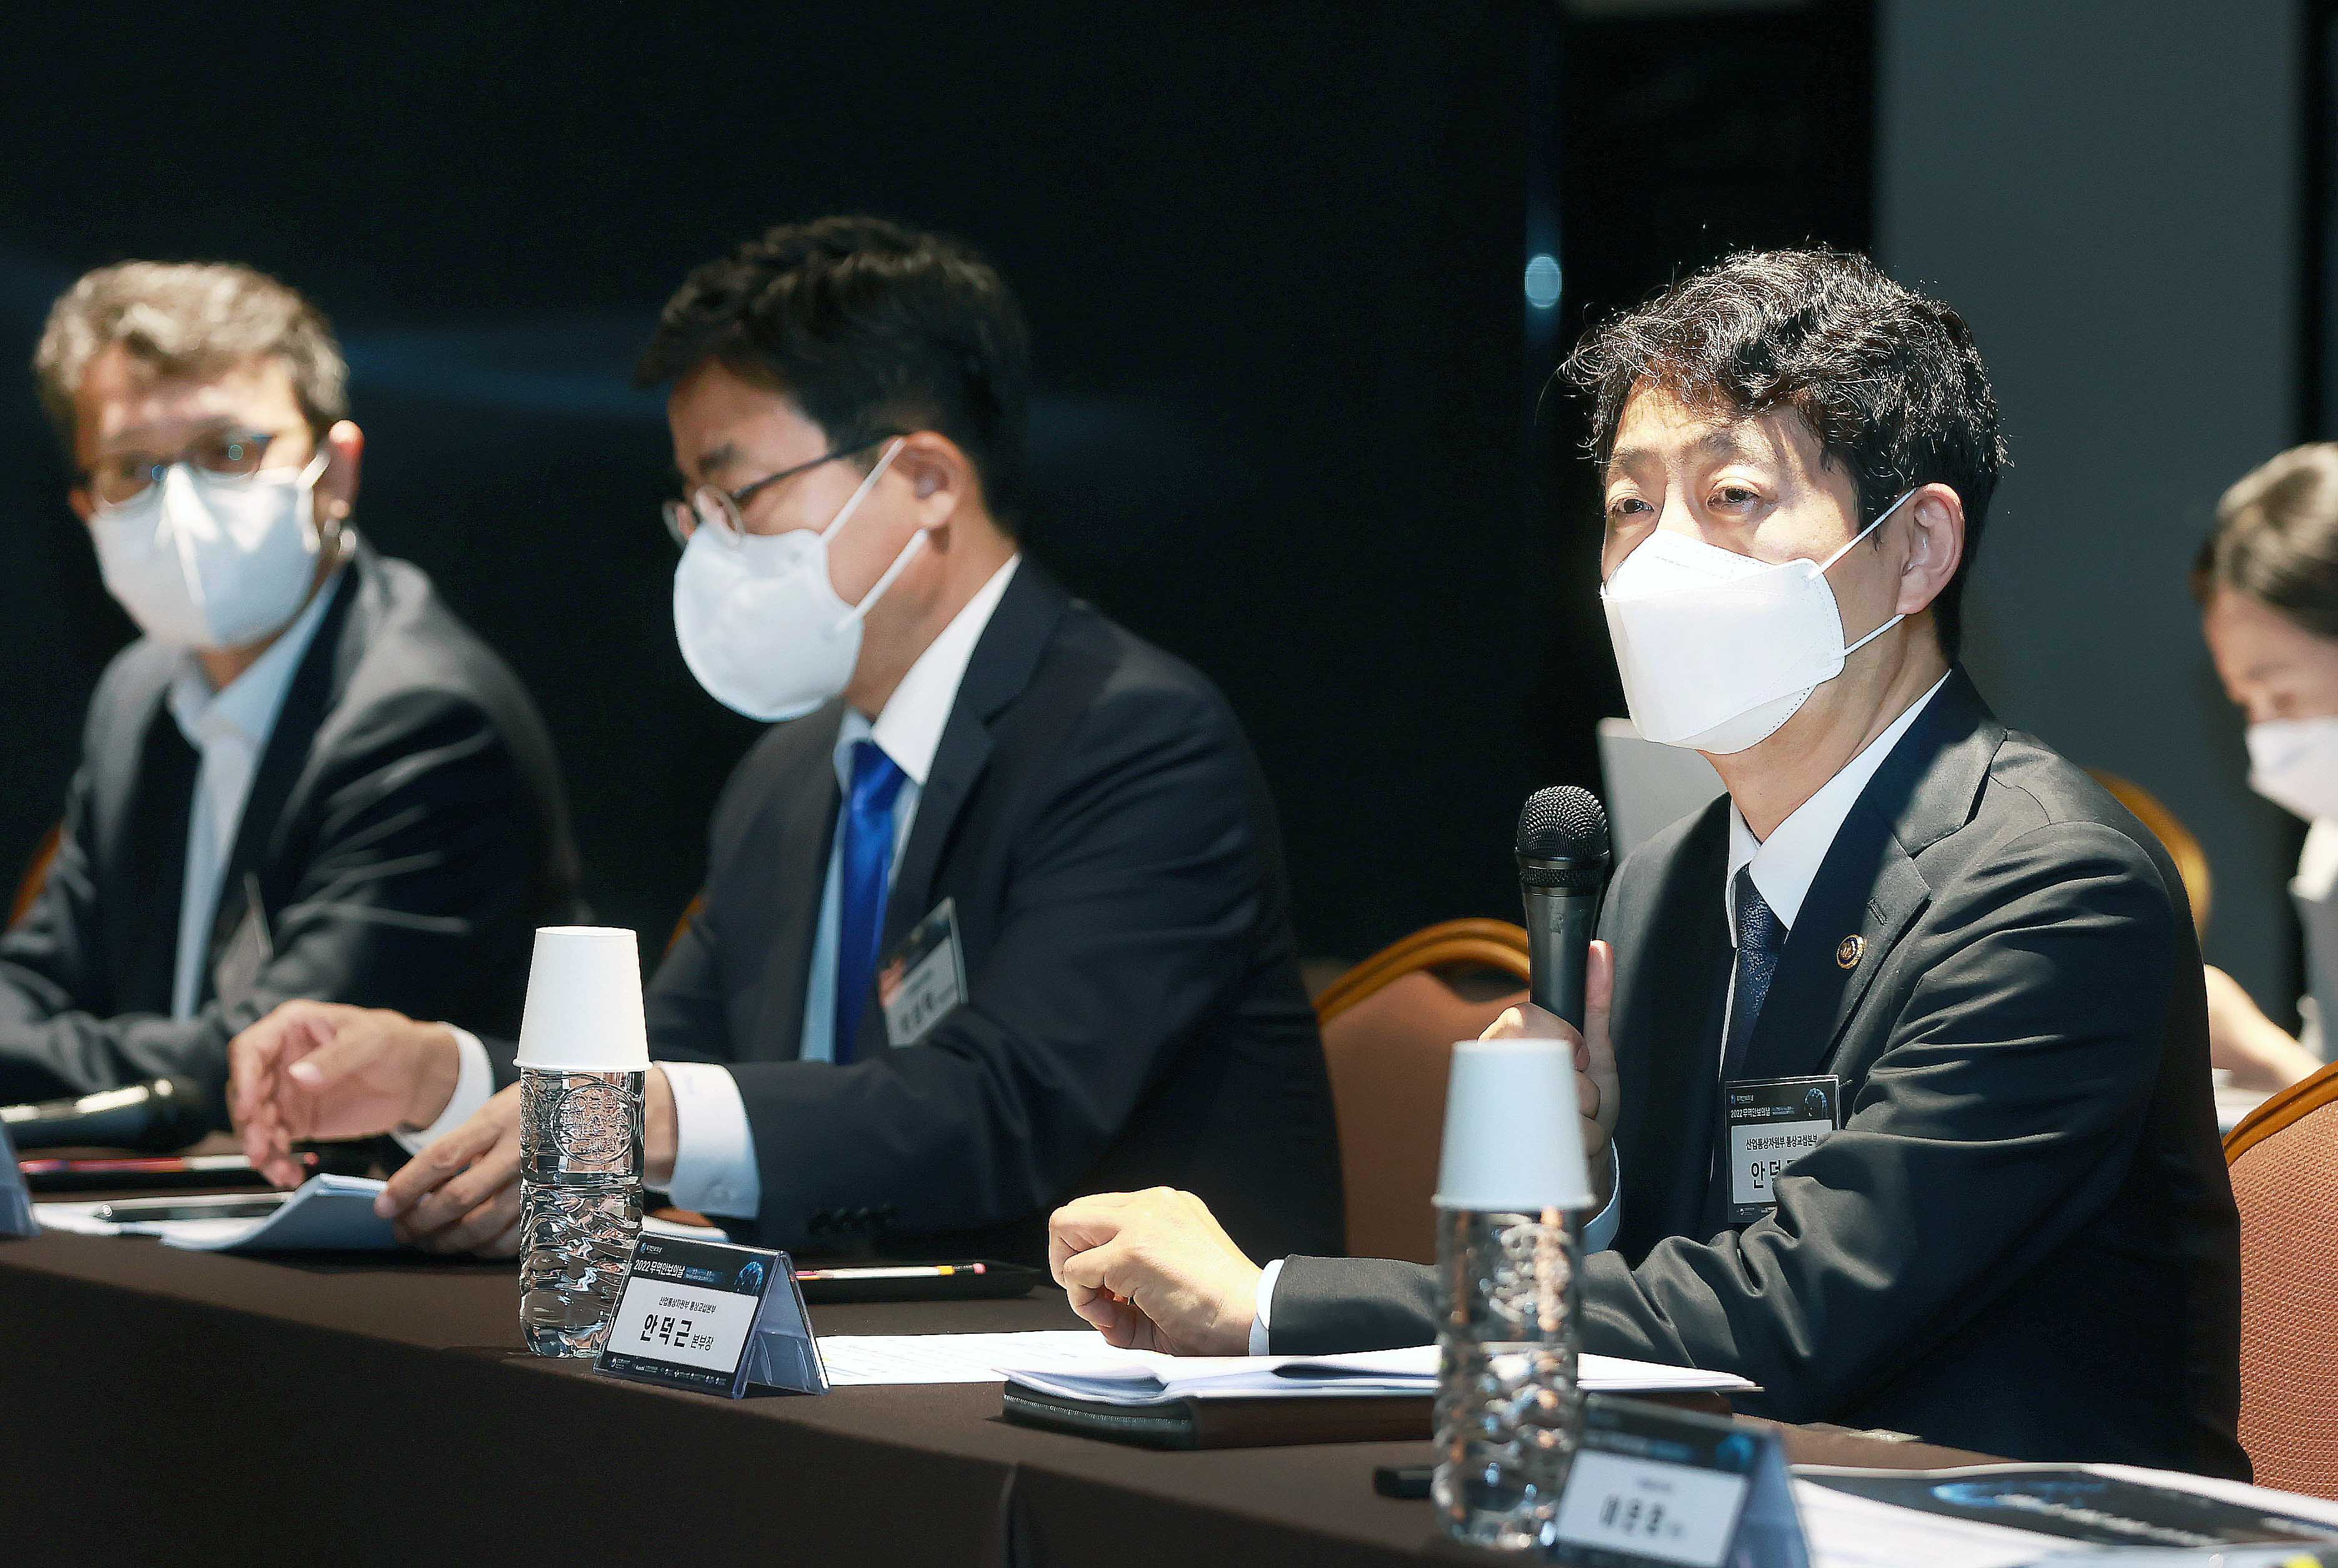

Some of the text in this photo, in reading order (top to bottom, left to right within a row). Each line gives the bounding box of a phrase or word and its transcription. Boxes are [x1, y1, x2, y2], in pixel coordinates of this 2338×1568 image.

[1746, 1137, 1785, 1150] 산업통상자원부
[659, 1296, 690, 1309] 산업통상자원부
[690, 1333, 715, 1351] 본부장
